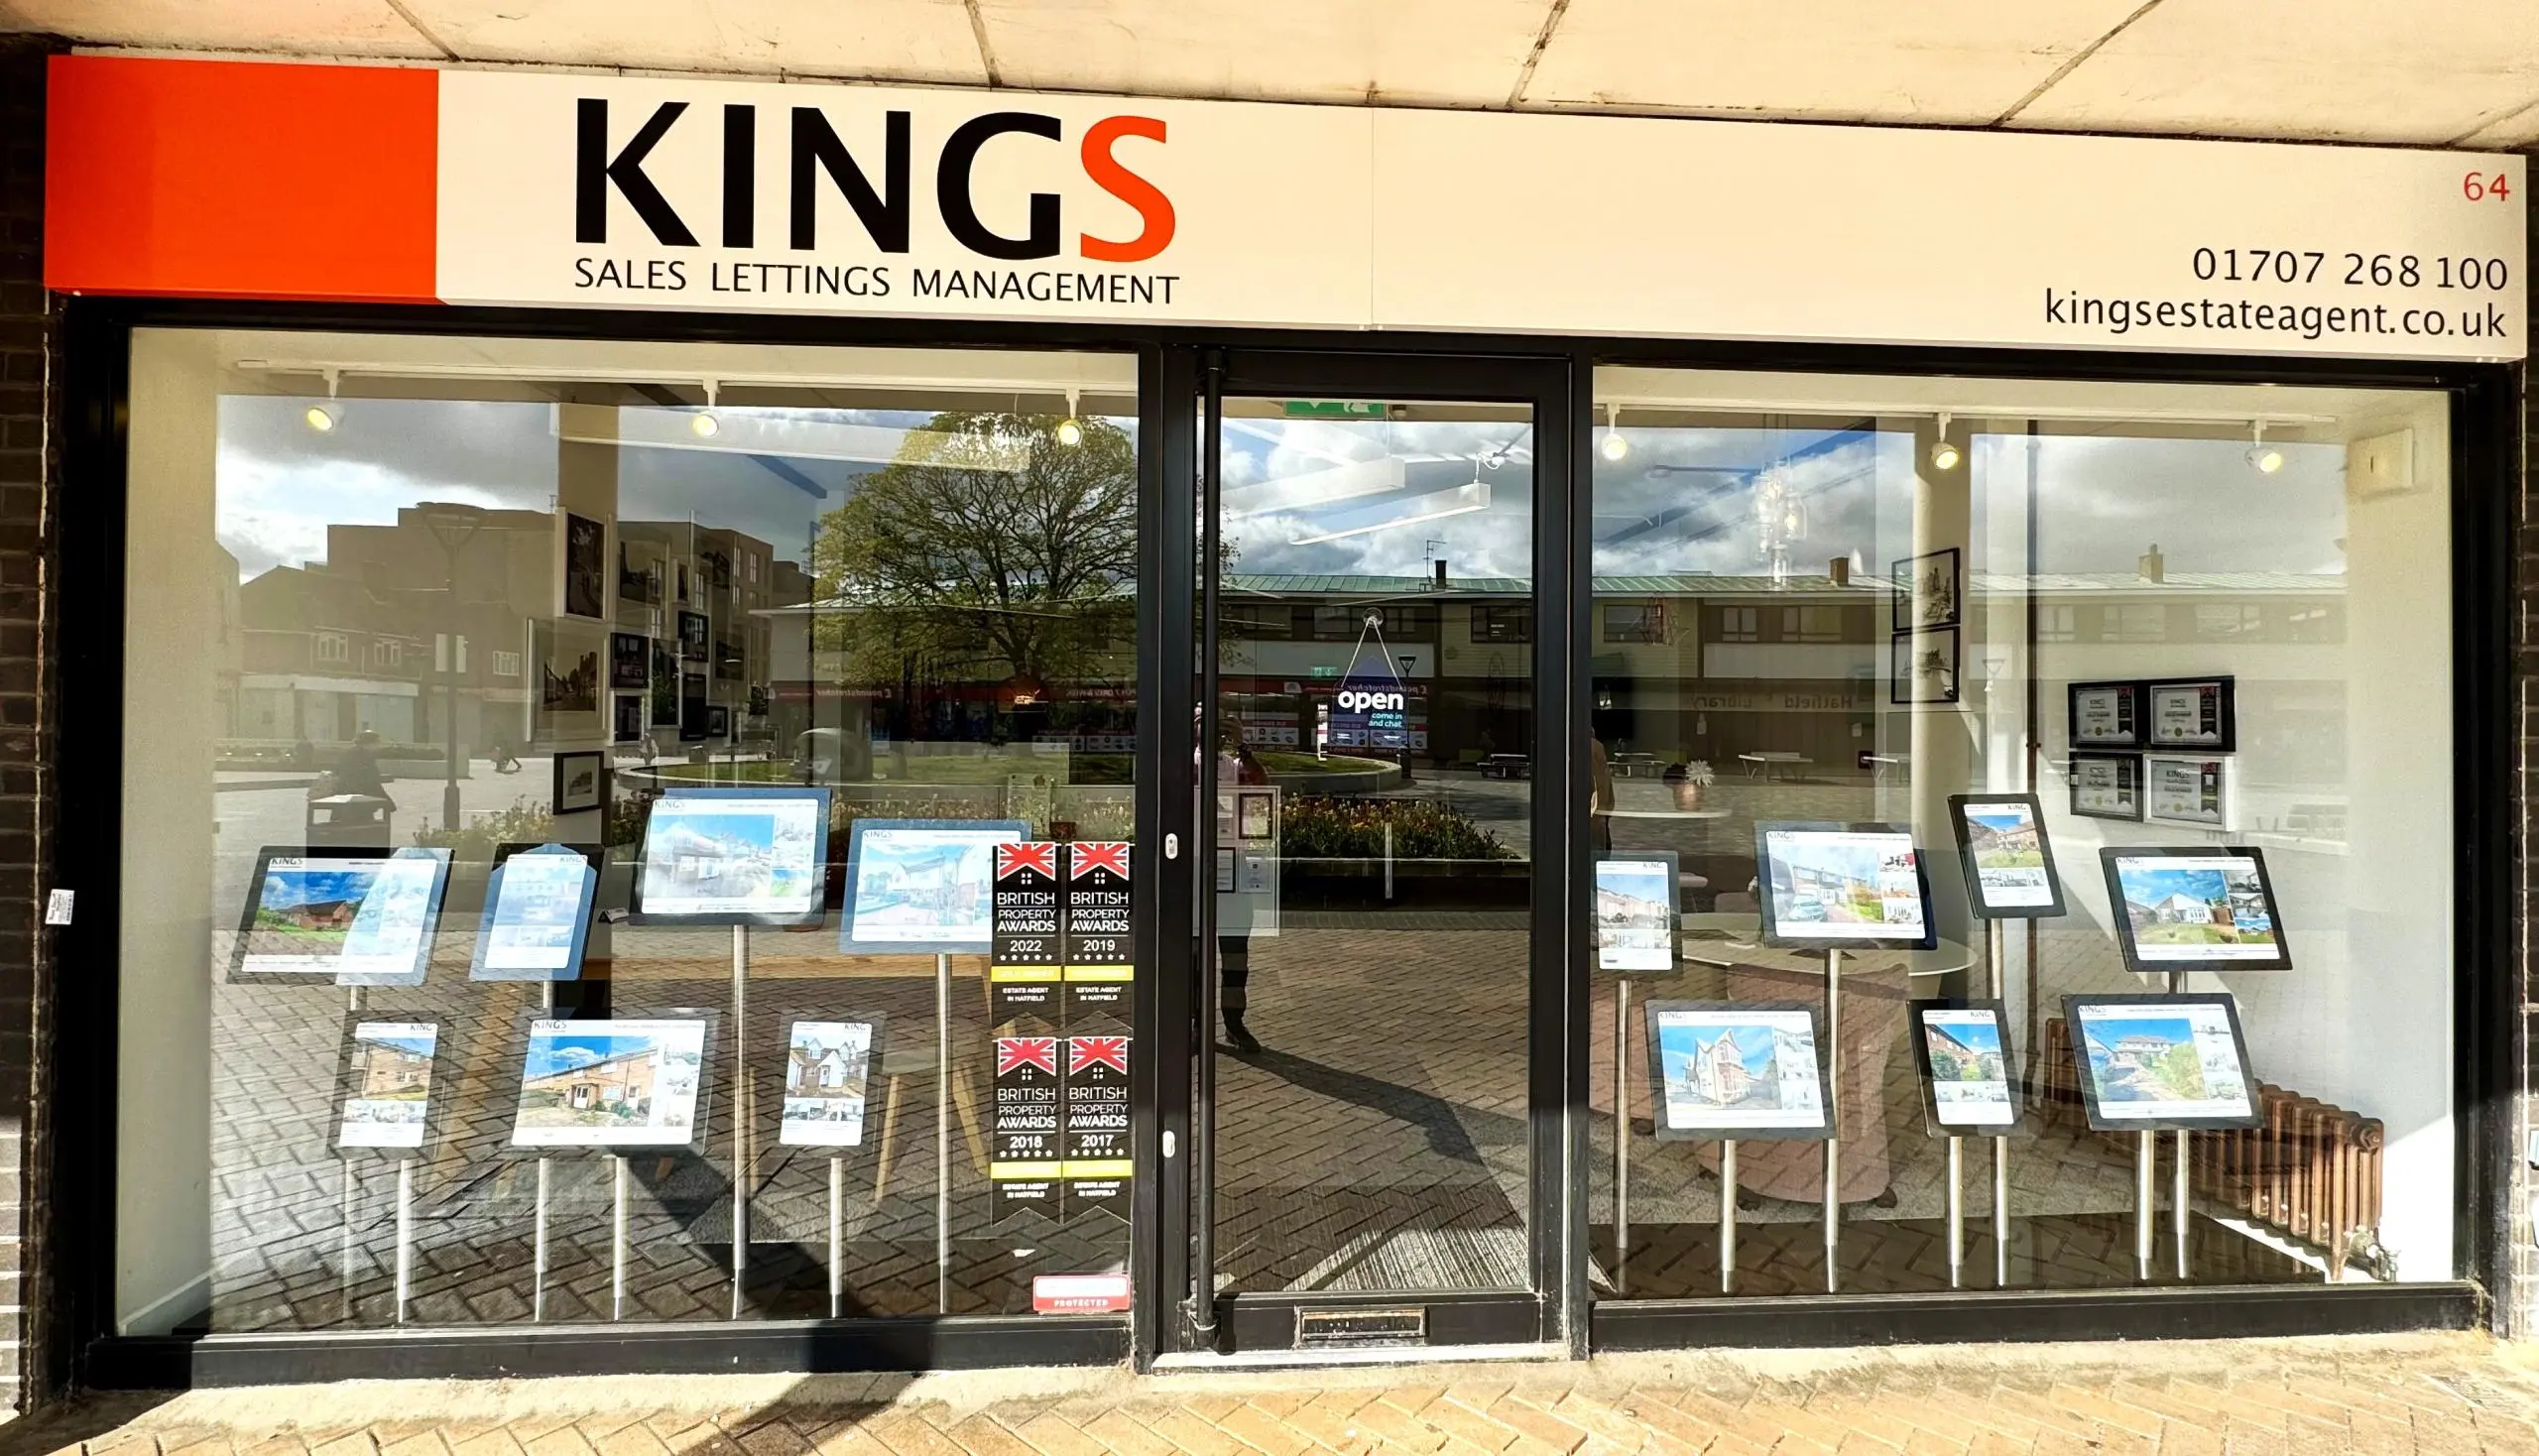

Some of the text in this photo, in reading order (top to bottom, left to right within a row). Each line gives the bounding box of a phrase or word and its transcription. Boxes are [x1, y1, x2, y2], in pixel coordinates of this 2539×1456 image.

[576, 97, 1176, 263] KINGS
[2463, 172, 2510, 201] 64
[2193, 248, 2508, 291] 01707 268 100
[575, 257, 1180, 304] SALES LETTINGS MANAGEMENT
[2045, 289, 2506, 339] kingsestateagent.co.uk
[1338, 691, 1403, 713] open
[997, 892, 1055, 905] BRITISH
[1070, 892, 1129, 905] BRITISH
[998, 910, 1056, 919] PROPERTY
[1071, 910, 1130, 919] PROPERTY
[997, 919, 1056, 932] AWARDS
[1070, 919, 1130, 932] AWARDS
[1010, 939, 1042, 952] 2022
[1082, 939, 1116, 952] 2019
[997, 1088, 1056, 1101] BRITISH
[1068, 1087, 1128, 1100] BRITISH
[998, 1105, 1056, 1116] PROPERTY
[1069, 1104, 1129, 1115] PROPERTY
[997, 1116, 1056, 1129] AWARDS
[1068, 1115, 1128, 1128] AWARDS
[1010, 1136, 1042, 1150] 2018
[1081, 1135, 1115, 1148] 2017
[1054, 1298, 1109, 1307] PROTECTED
